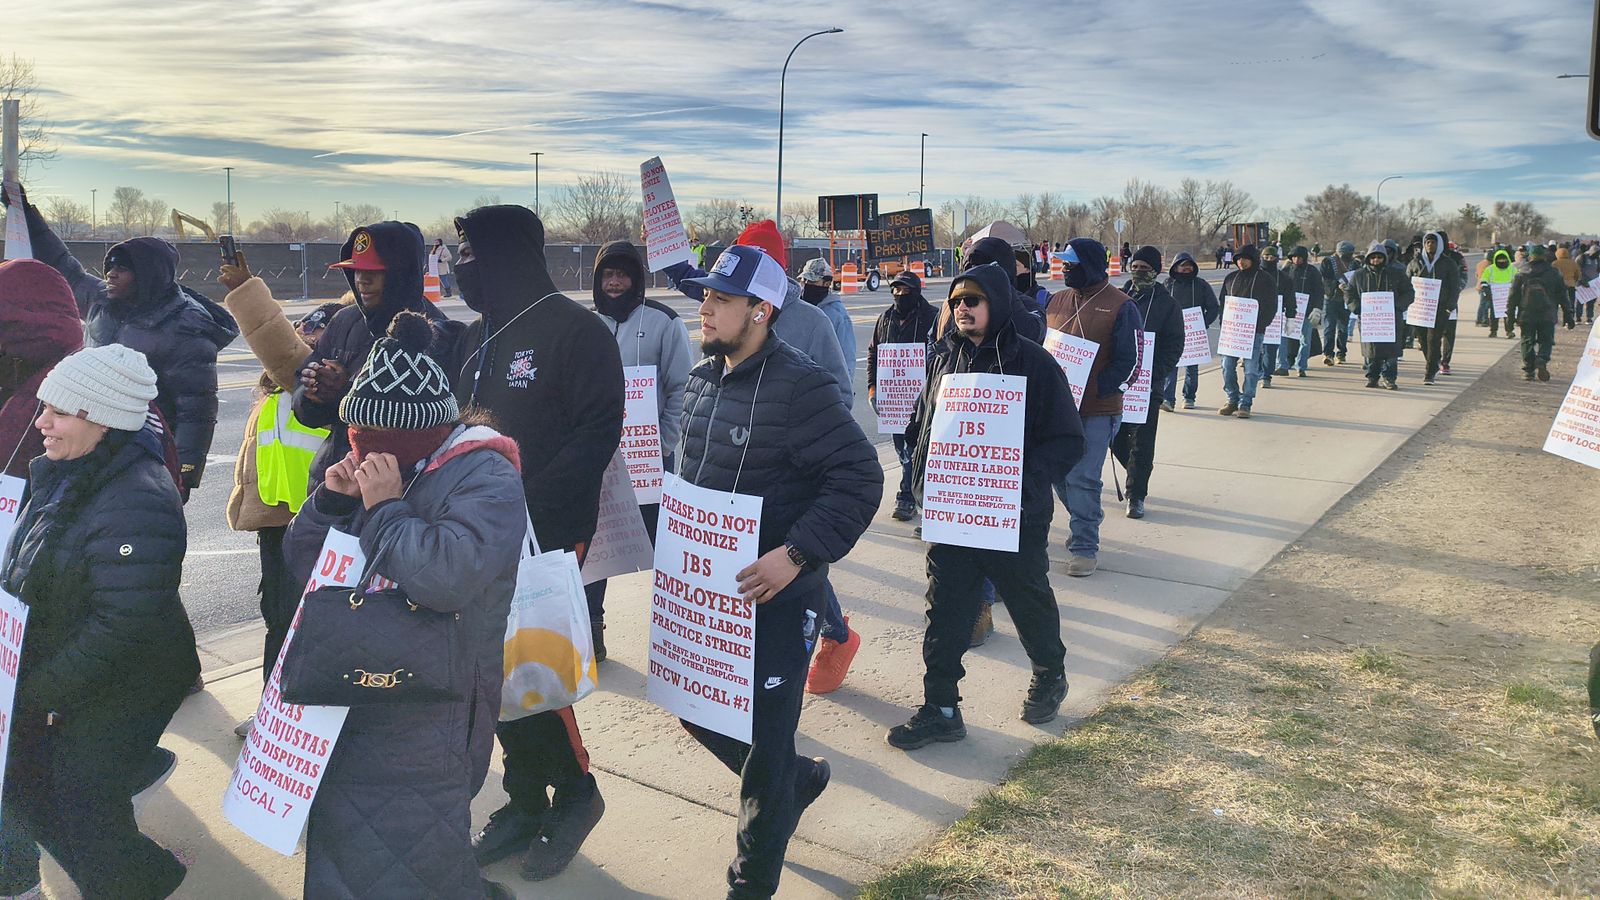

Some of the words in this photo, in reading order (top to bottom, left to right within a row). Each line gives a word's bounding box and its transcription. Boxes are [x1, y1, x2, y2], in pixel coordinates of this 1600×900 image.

[650, 166, 664, 177] NOT
[644, 192, 656, 205] JBS
[888, 214, 910, 226] JBS
[870, 224, 930, 243] EMPLOYEE
[661, 242, 680, 255] LOCAL
[875, 240, 928, 257] PARKING
[878, 349, 897, 357] FAVOR
[900, 349, 910, 357] DE
[913, 349, 924, 358] NO
[1065, 345, 1075, 353] DO
[1076, 348, 1094, 359] NOT
[878, 359, 924, 367] PATROCINAR
[893, 369, 906, 378] JBS
[633, 378, 654, 387] NOT
[973, 388, 992, 399] DO
[995, 390, 1023, 402] NOT
[945, 402, 1009, 414] PATRONIZE
[958, 421, 985, 437] JBS
[629, 439, 659, 448] LABOR
[930, 442, 1020, 461] EMPLOYEES
[1576, 437, 1600, 452] LOCA
[627, 450, 659, 459] STRIKE
[928, 459, 941, 469] ON
[944, 461, 979, 472] UNFAIR
[982, 464, 1020, 476] LABOR
[927, 473, 975, 486] PRACTICE
[978, 478, 1018, 490] STRIKE
[975, 494, 1003, 502] DISPUTE
[978, 501, 1016, 510] EMPLOYER
[662, 493, 694, 521] PLEASE
[696, 508, 718, 526] DO
[722, 514, 756, 534] NOT
[925, 509, 955, 523] UFCW
[958, 513, 999, 527] LOCAL
[1002, 517, 1016, 529] #7
[668, 517, 738, 552] PATRONIZE
[320, 549, 354, 583] DE
[682, 551, 712, 577] JBS
[655, 569, 753, 619] EMPLOYEES
[654, 594, 666, 610] ON
[669, 601, 706, 627] UNFAIR
[709, 616, 752, 640] LABOR
[9, 617, 22, 648] NO
[653, 611, 702, 644] PRACTICE
[705, 635, 751, 659] STRIKE
[652, 642, 667, 655] WITH
[668, 650, 680, 662] ANY
[682, 658, 704, 672] OTHER
[706, 666, 749, 686] EMPLOYER
[663, 639, 672, 649] WE
[672, 643, 688, 658] HAVE
[690, 652, 701, 661] NO
[702, 657, 734, 672] DISPUTE
[650, 660, 681, 687] UFCW
[683, 676, 730, 706] LOCAL
[733, 694, 750, 712] #7
[268, 716, 329, 757] INJUSTAS
[262, 740, 320, 778] DISPUTAS
[237, 773, 276, 814] LOCAL
[282, 803, 293, 818] 7
